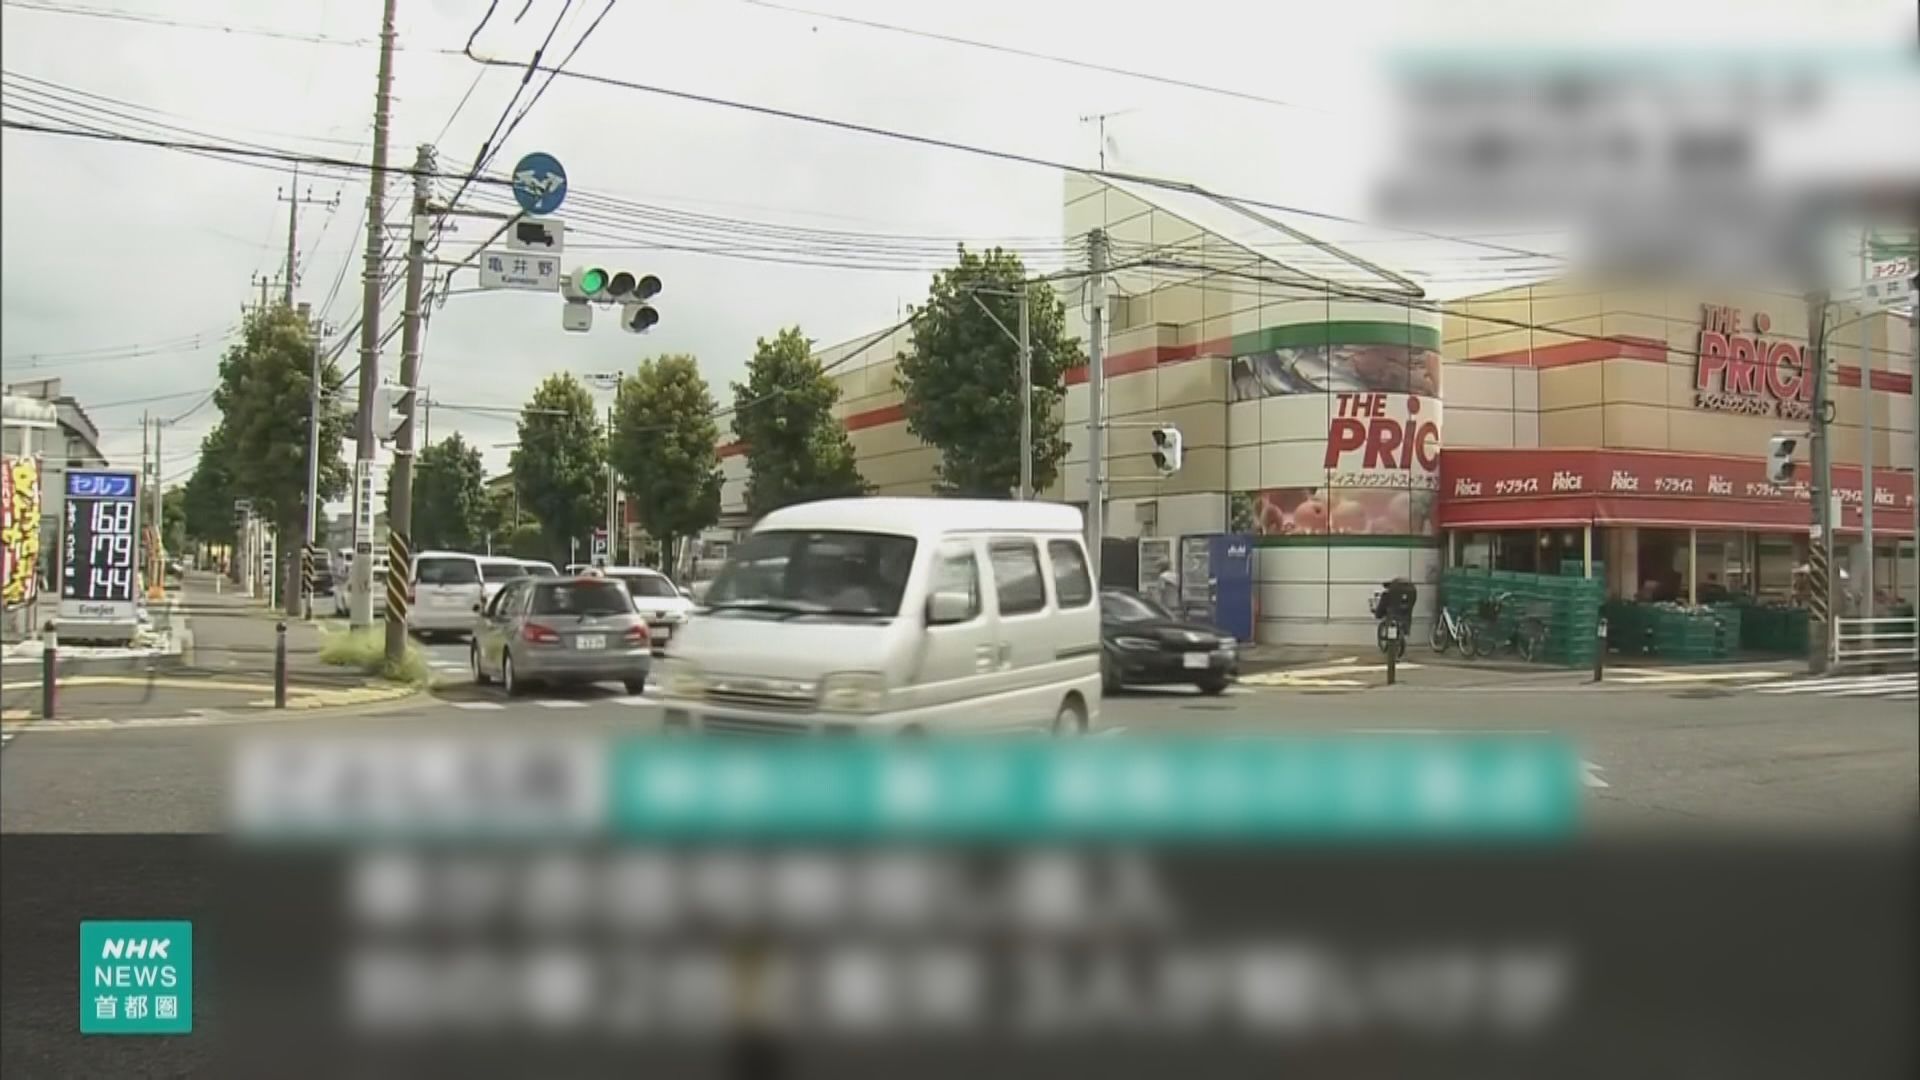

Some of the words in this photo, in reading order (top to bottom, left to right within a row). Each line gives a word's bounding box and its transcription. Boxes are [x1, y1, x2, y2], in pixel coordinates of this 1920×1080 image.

[488, 256, 553, 277] 亀井野
[1702, 304, 1742, 333] THE
[1337, 394, 1387, 417] THE
[71, 474, 131, 496] セルフ
[91, 502, 133, 533] 168
[90, 534, 132, 567] 179
[89, 568, 131, 598] 144
